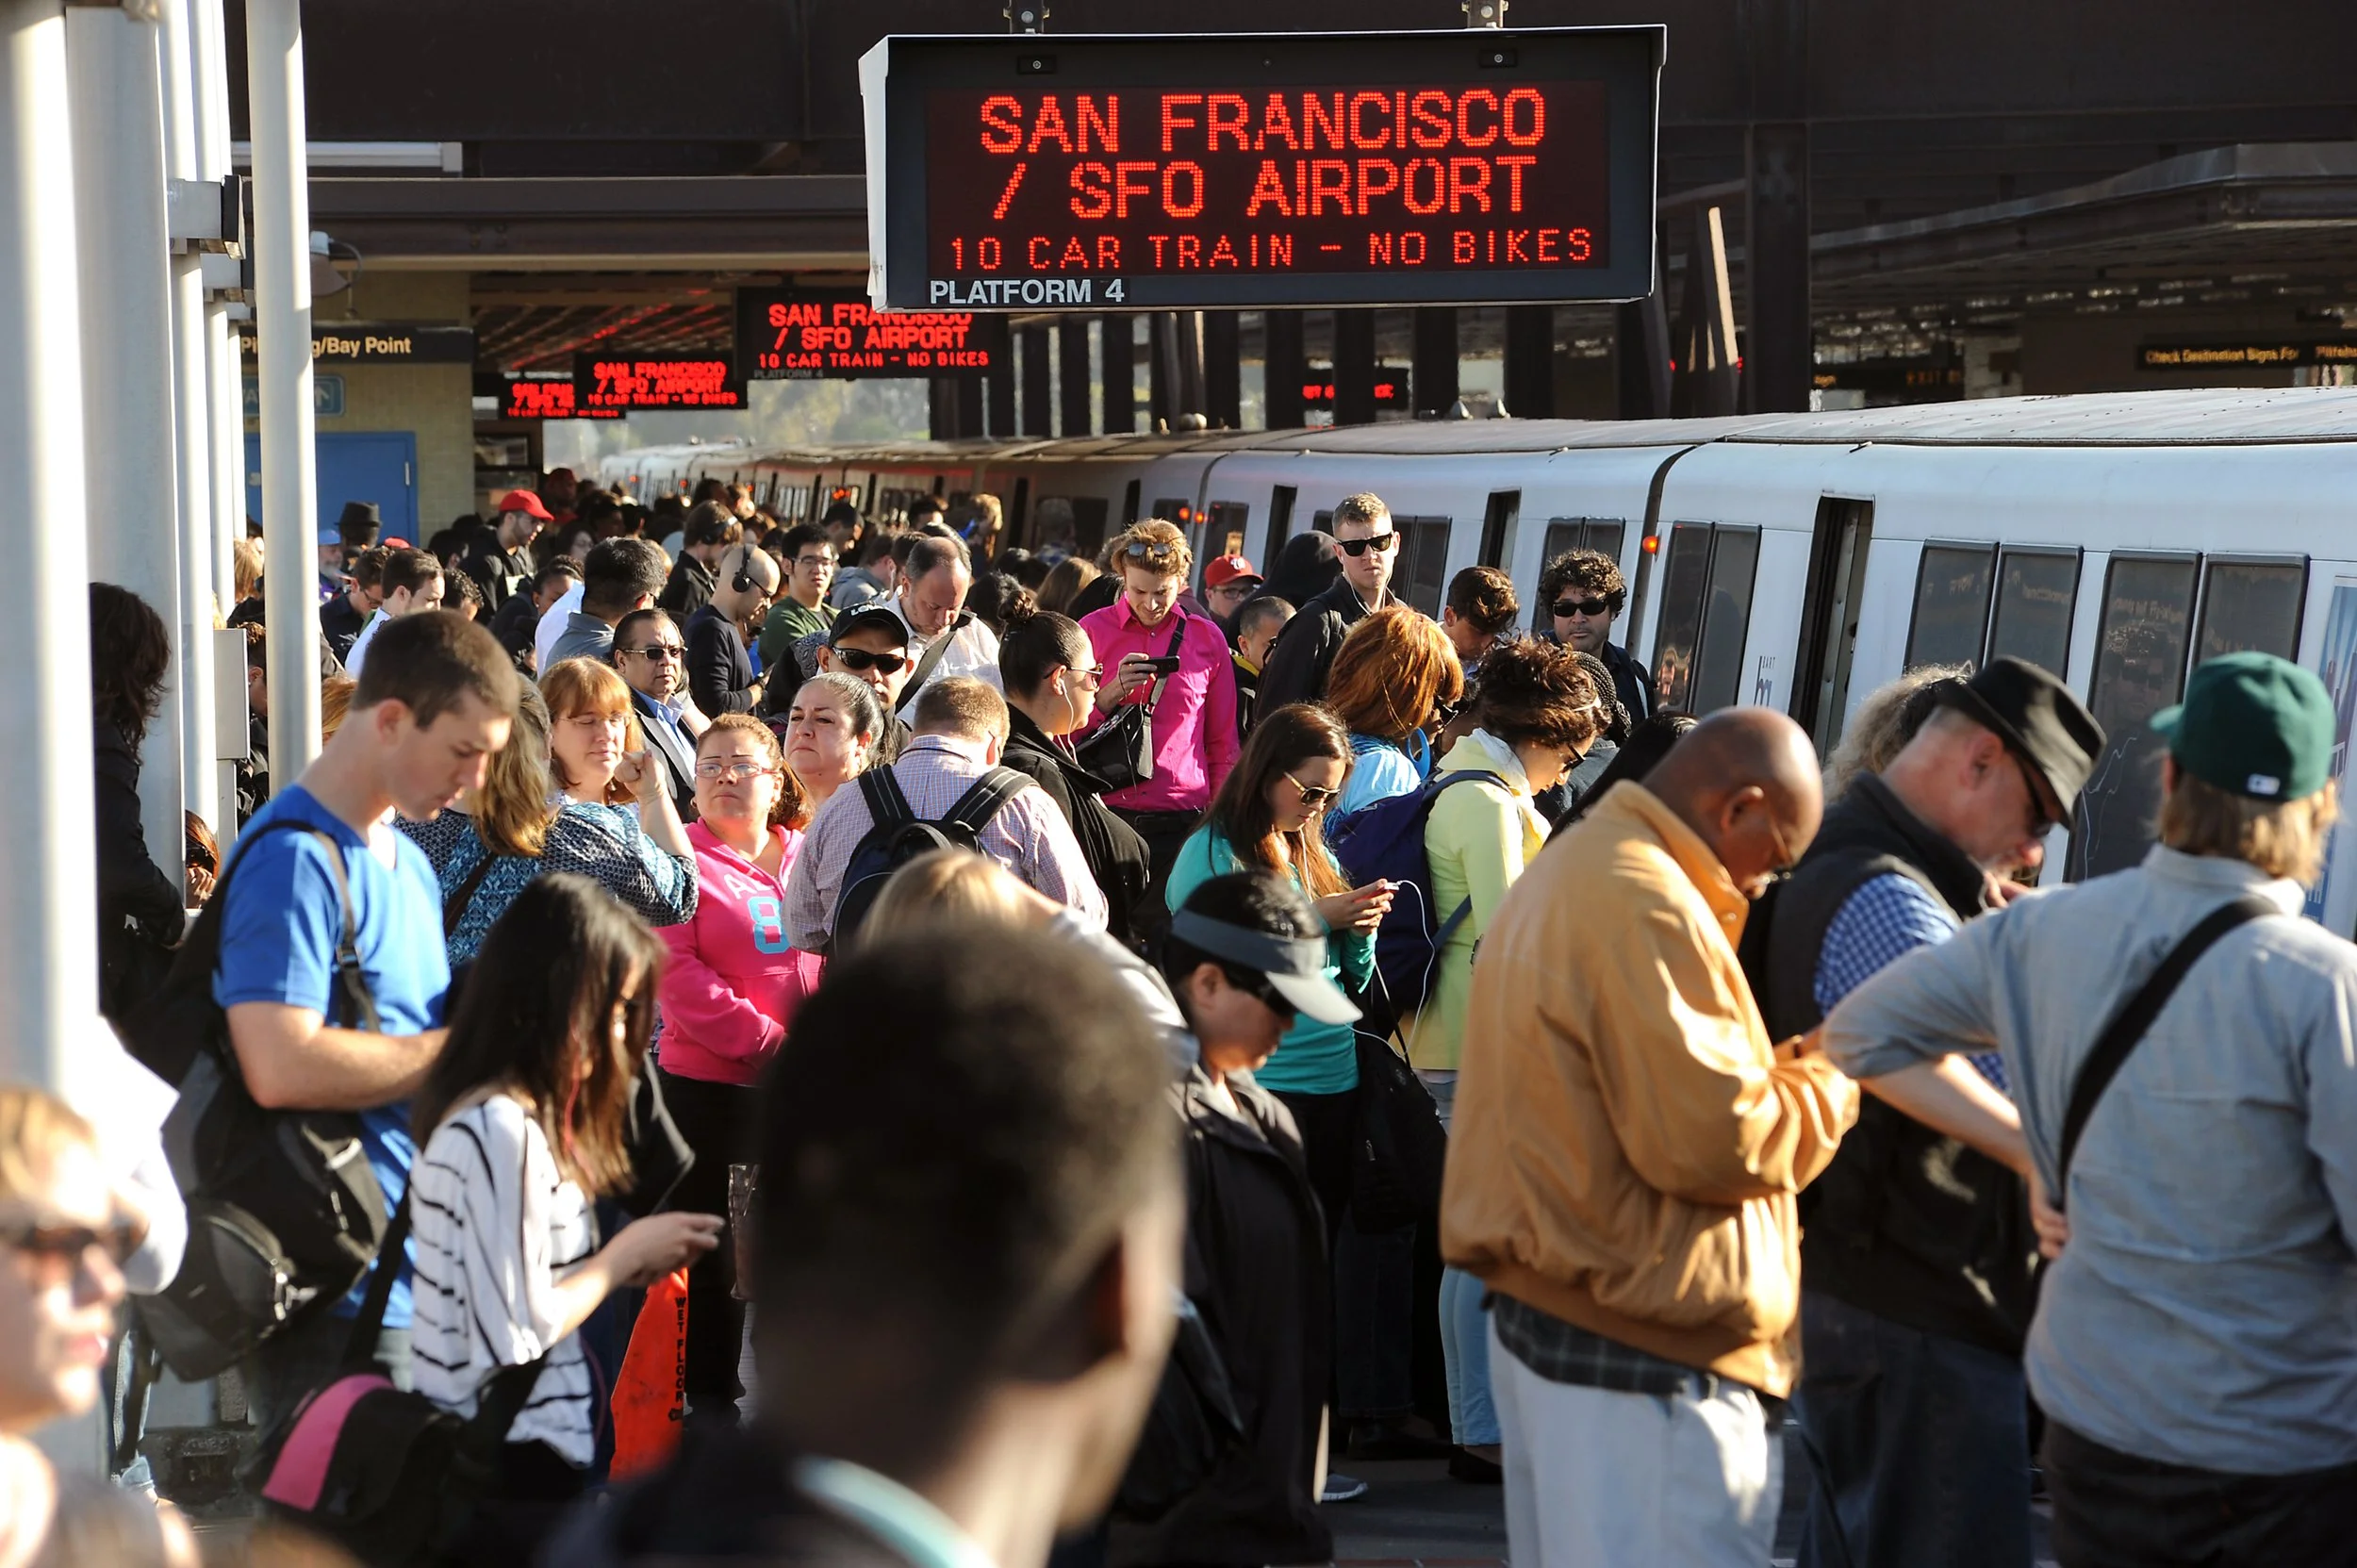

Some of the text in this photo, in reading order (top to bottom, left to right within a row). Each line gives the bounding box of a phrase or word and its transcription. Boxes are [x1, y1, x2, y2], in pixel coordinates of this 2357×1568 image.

[981, 88, 1546, 155] SAN FRANCISCO
[993, 155, 1538, 220] / SFO AIRPORT
[951, 237, 1002, 271] 10
[1028, 235, 1121, 271] CAR
[1147, 233, 1293, 269] TRAIN
[1369, 231, 1427, 265] NO
[1453, 227, 1591, 264] BIKES
[930, 278, 1126, 305] PLATFORM 4
[768, 304, 822, 327] SAN
[365, 336, 412, 354] Point
[774, 326, 970, 351] / SFO AIRPORT
[593, 362, 630, 379] SAN
[759, 354, 781, 369] 10
[785, 353, 823, 369] CAR
[829, 352, 884, 368] TRAIN
[906, 352, 931, 367] NO
[936, 351, 990, 367] BIKES
[675, 1296, 687, 1333] WET
[675, 1338, 685, 1402] FLOOR
